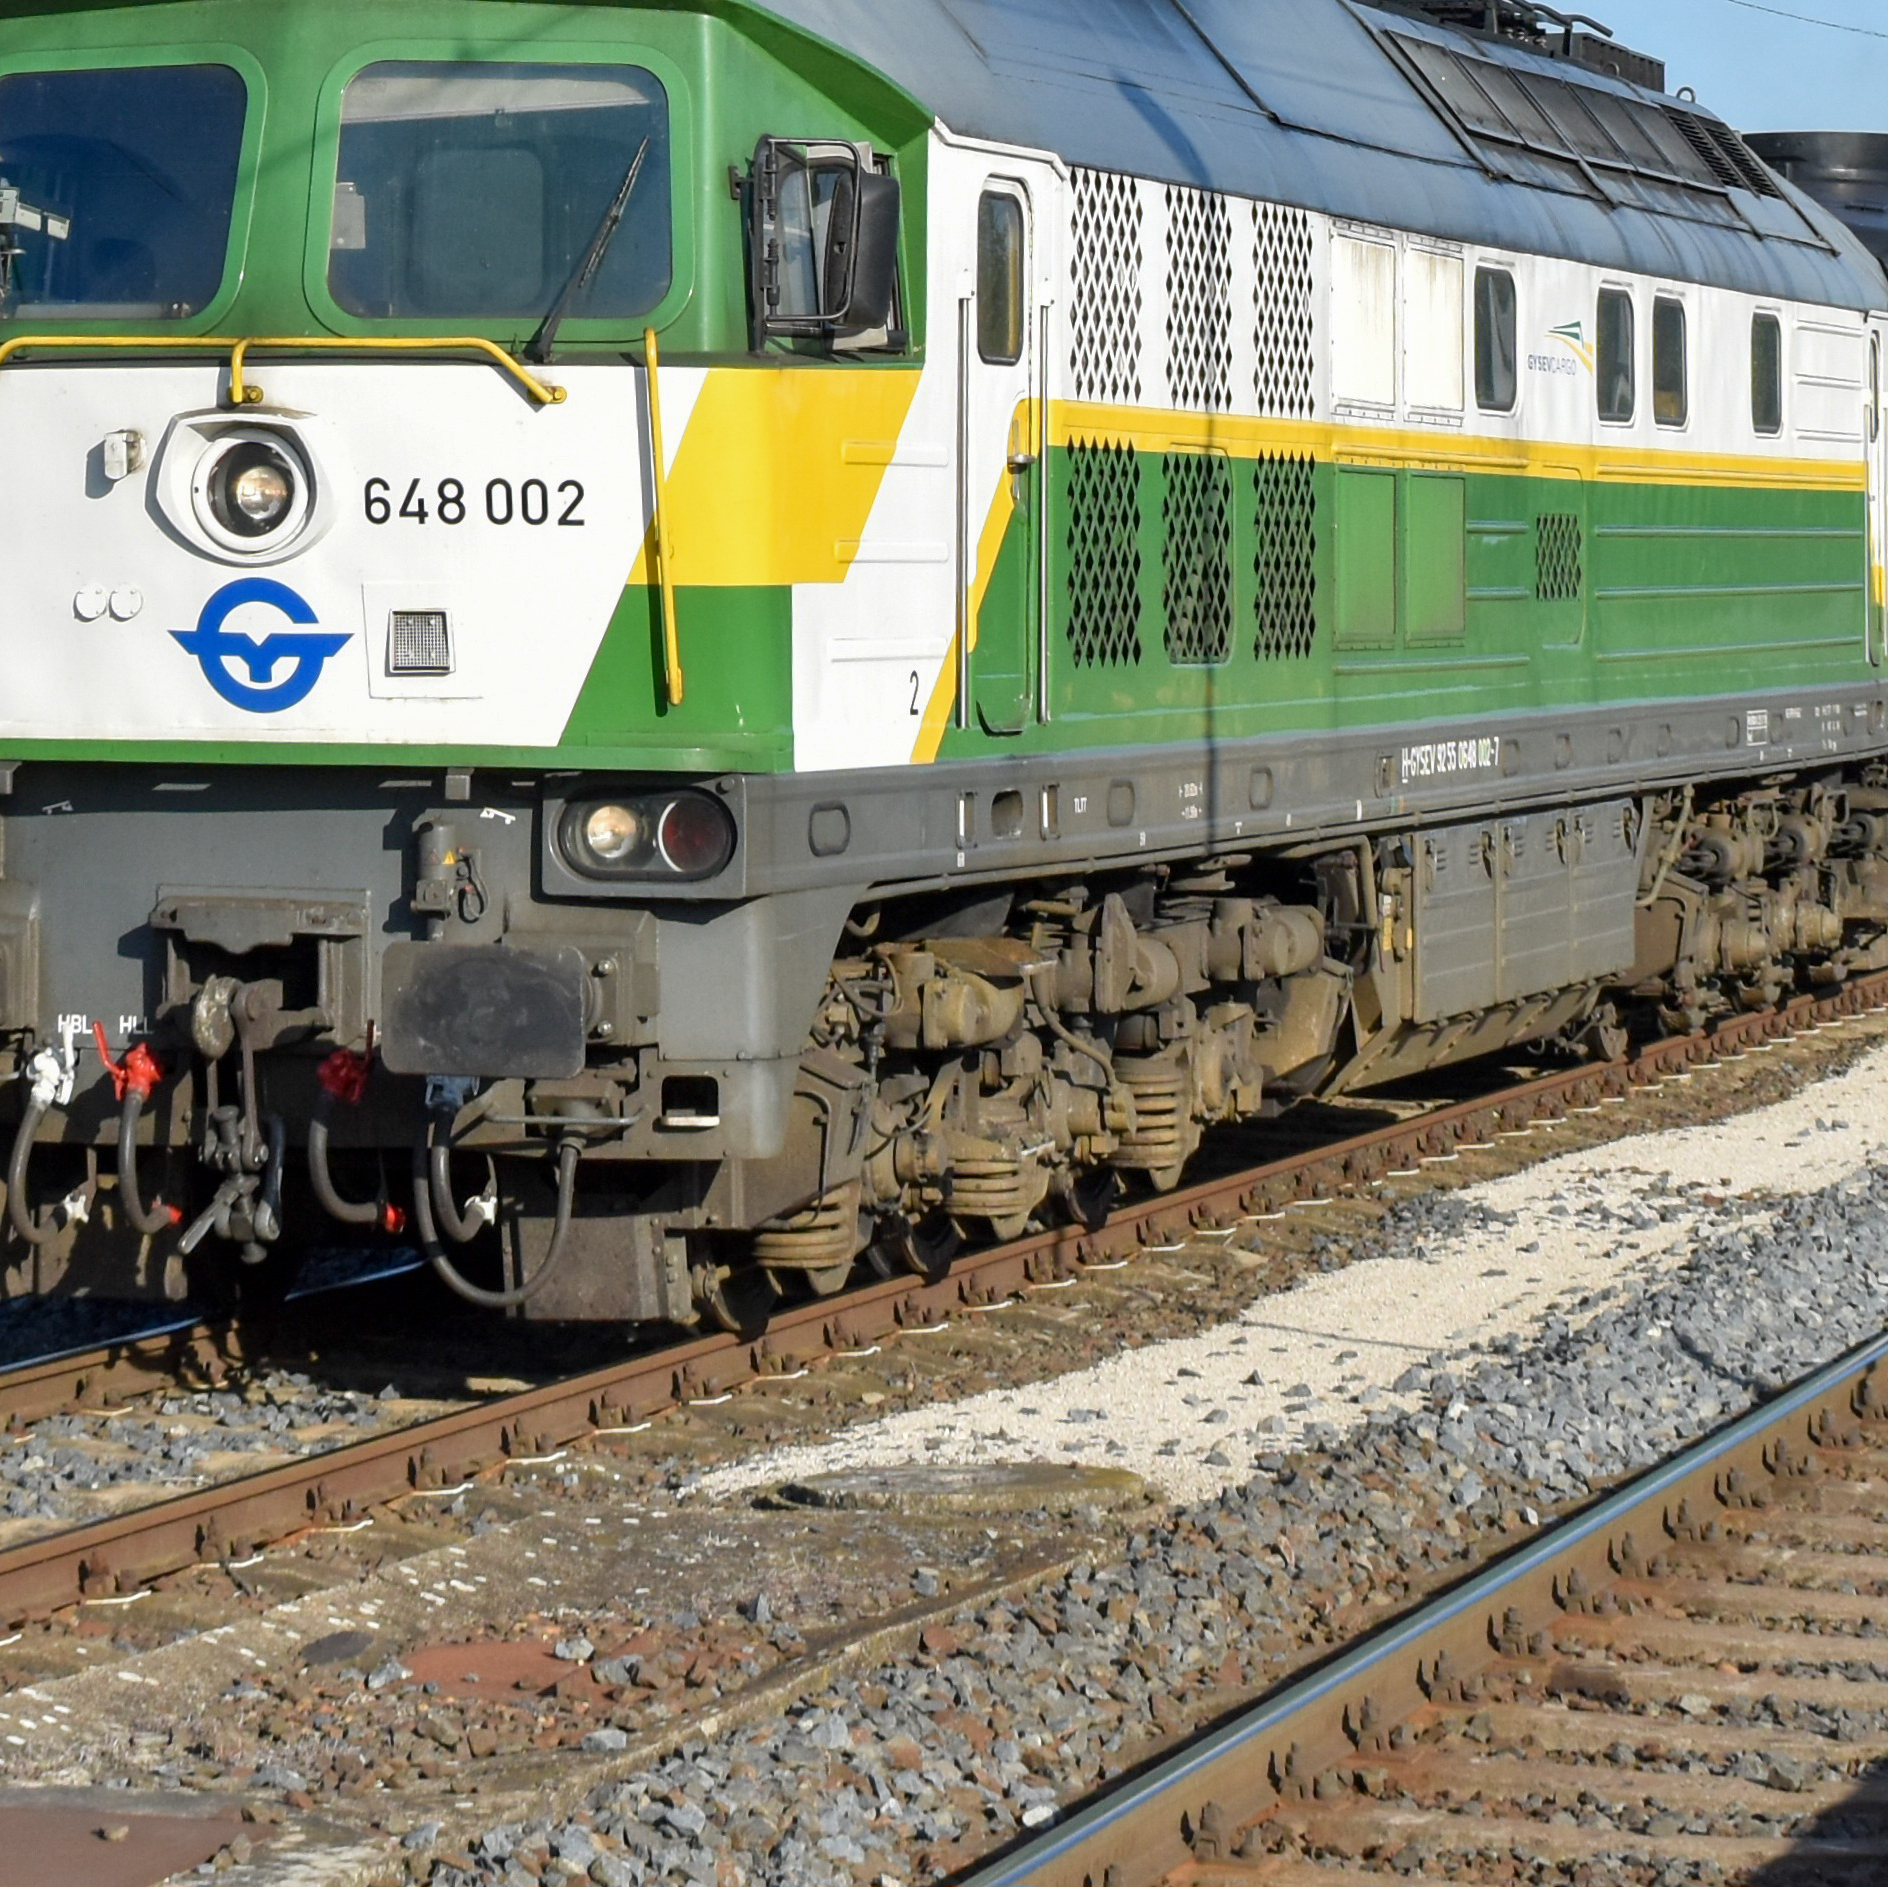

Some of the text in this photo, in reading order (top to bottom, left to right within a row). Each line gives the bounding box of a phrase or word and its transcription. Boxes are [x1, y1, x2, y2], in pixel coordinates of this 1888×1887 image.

[364, 476, 585, 527] 648 002
[909, 669, 919, 716] 2
